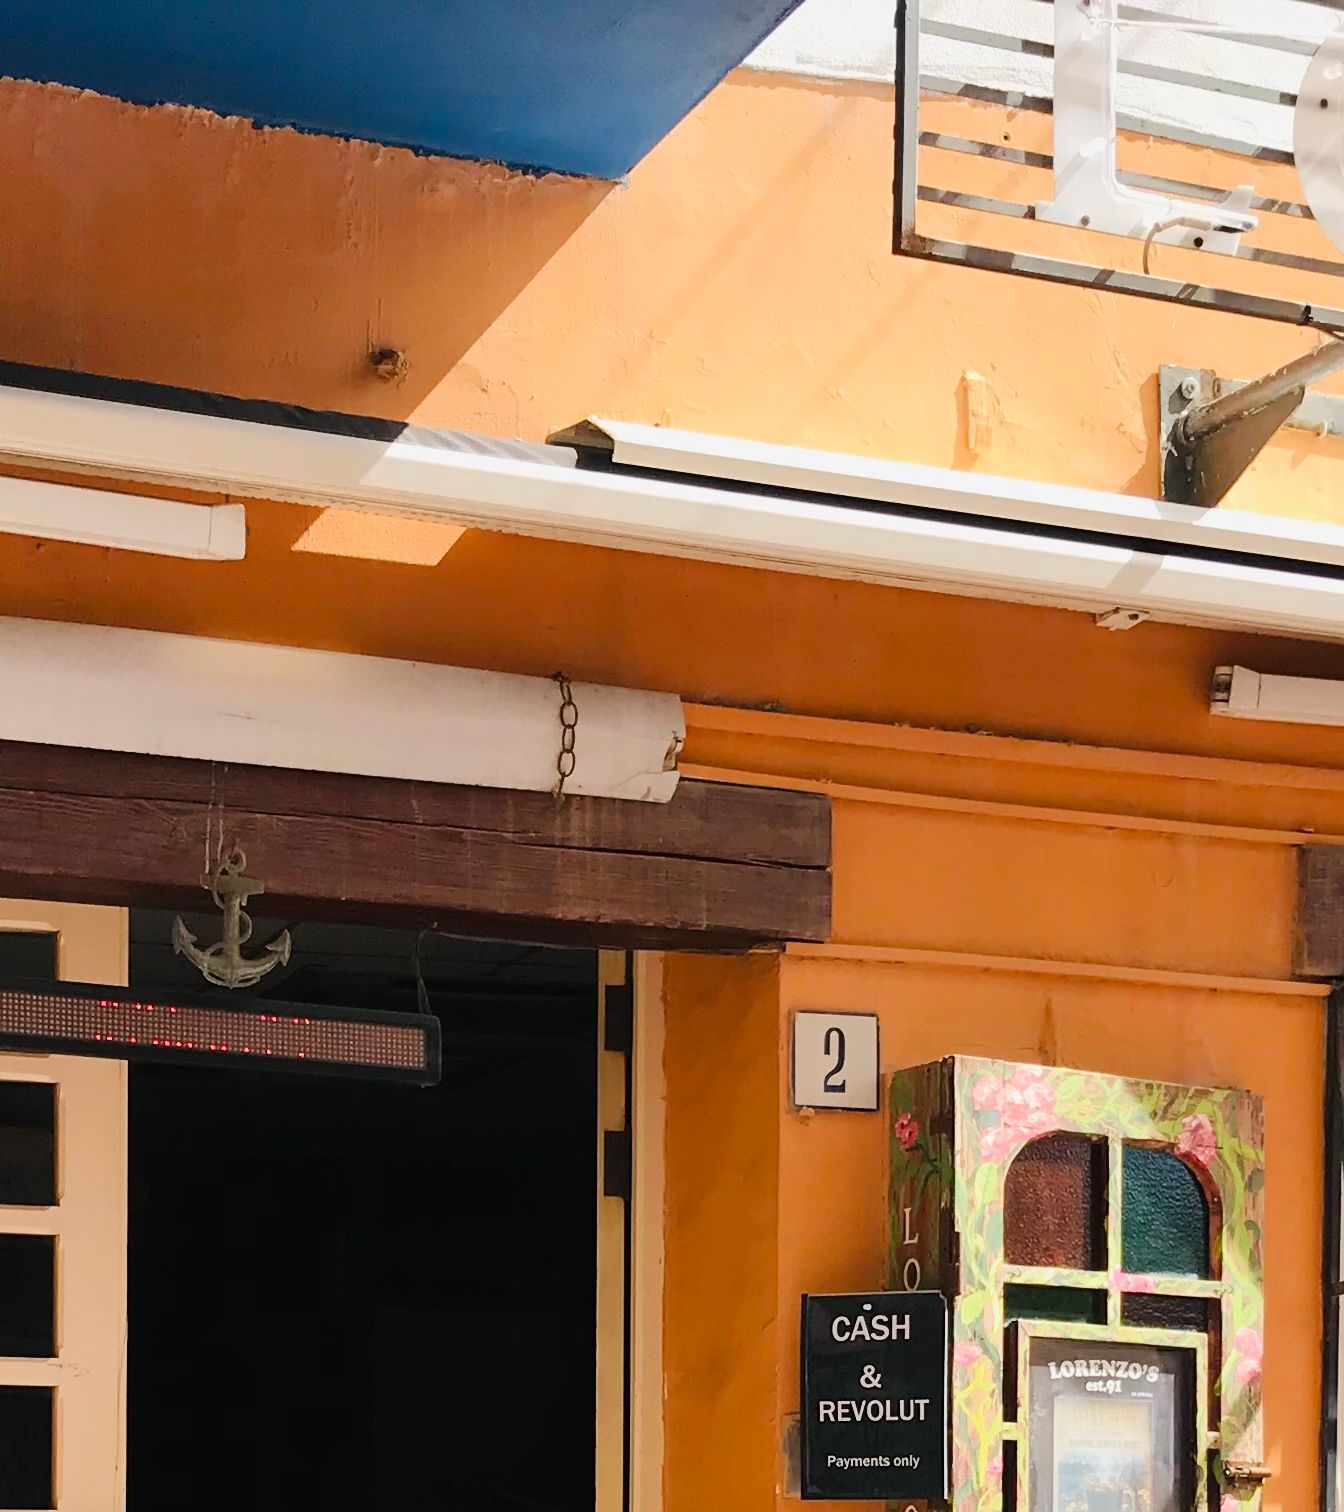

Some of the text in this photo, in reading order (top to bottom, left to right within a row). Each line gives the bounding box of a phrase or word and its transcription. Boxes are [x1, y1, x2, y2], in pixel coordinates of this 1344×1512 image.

[824, 1027, 845, 1093] 2
[832, 1315, 910, 1342] CASH
[860, 1364, 882, 1389] &
[1047, 1359, 1160, 1383] LORENZO'S
[819, 1399, 930, 1423] REVOLUT
[827, 1455, 920, 1470] Payments only
